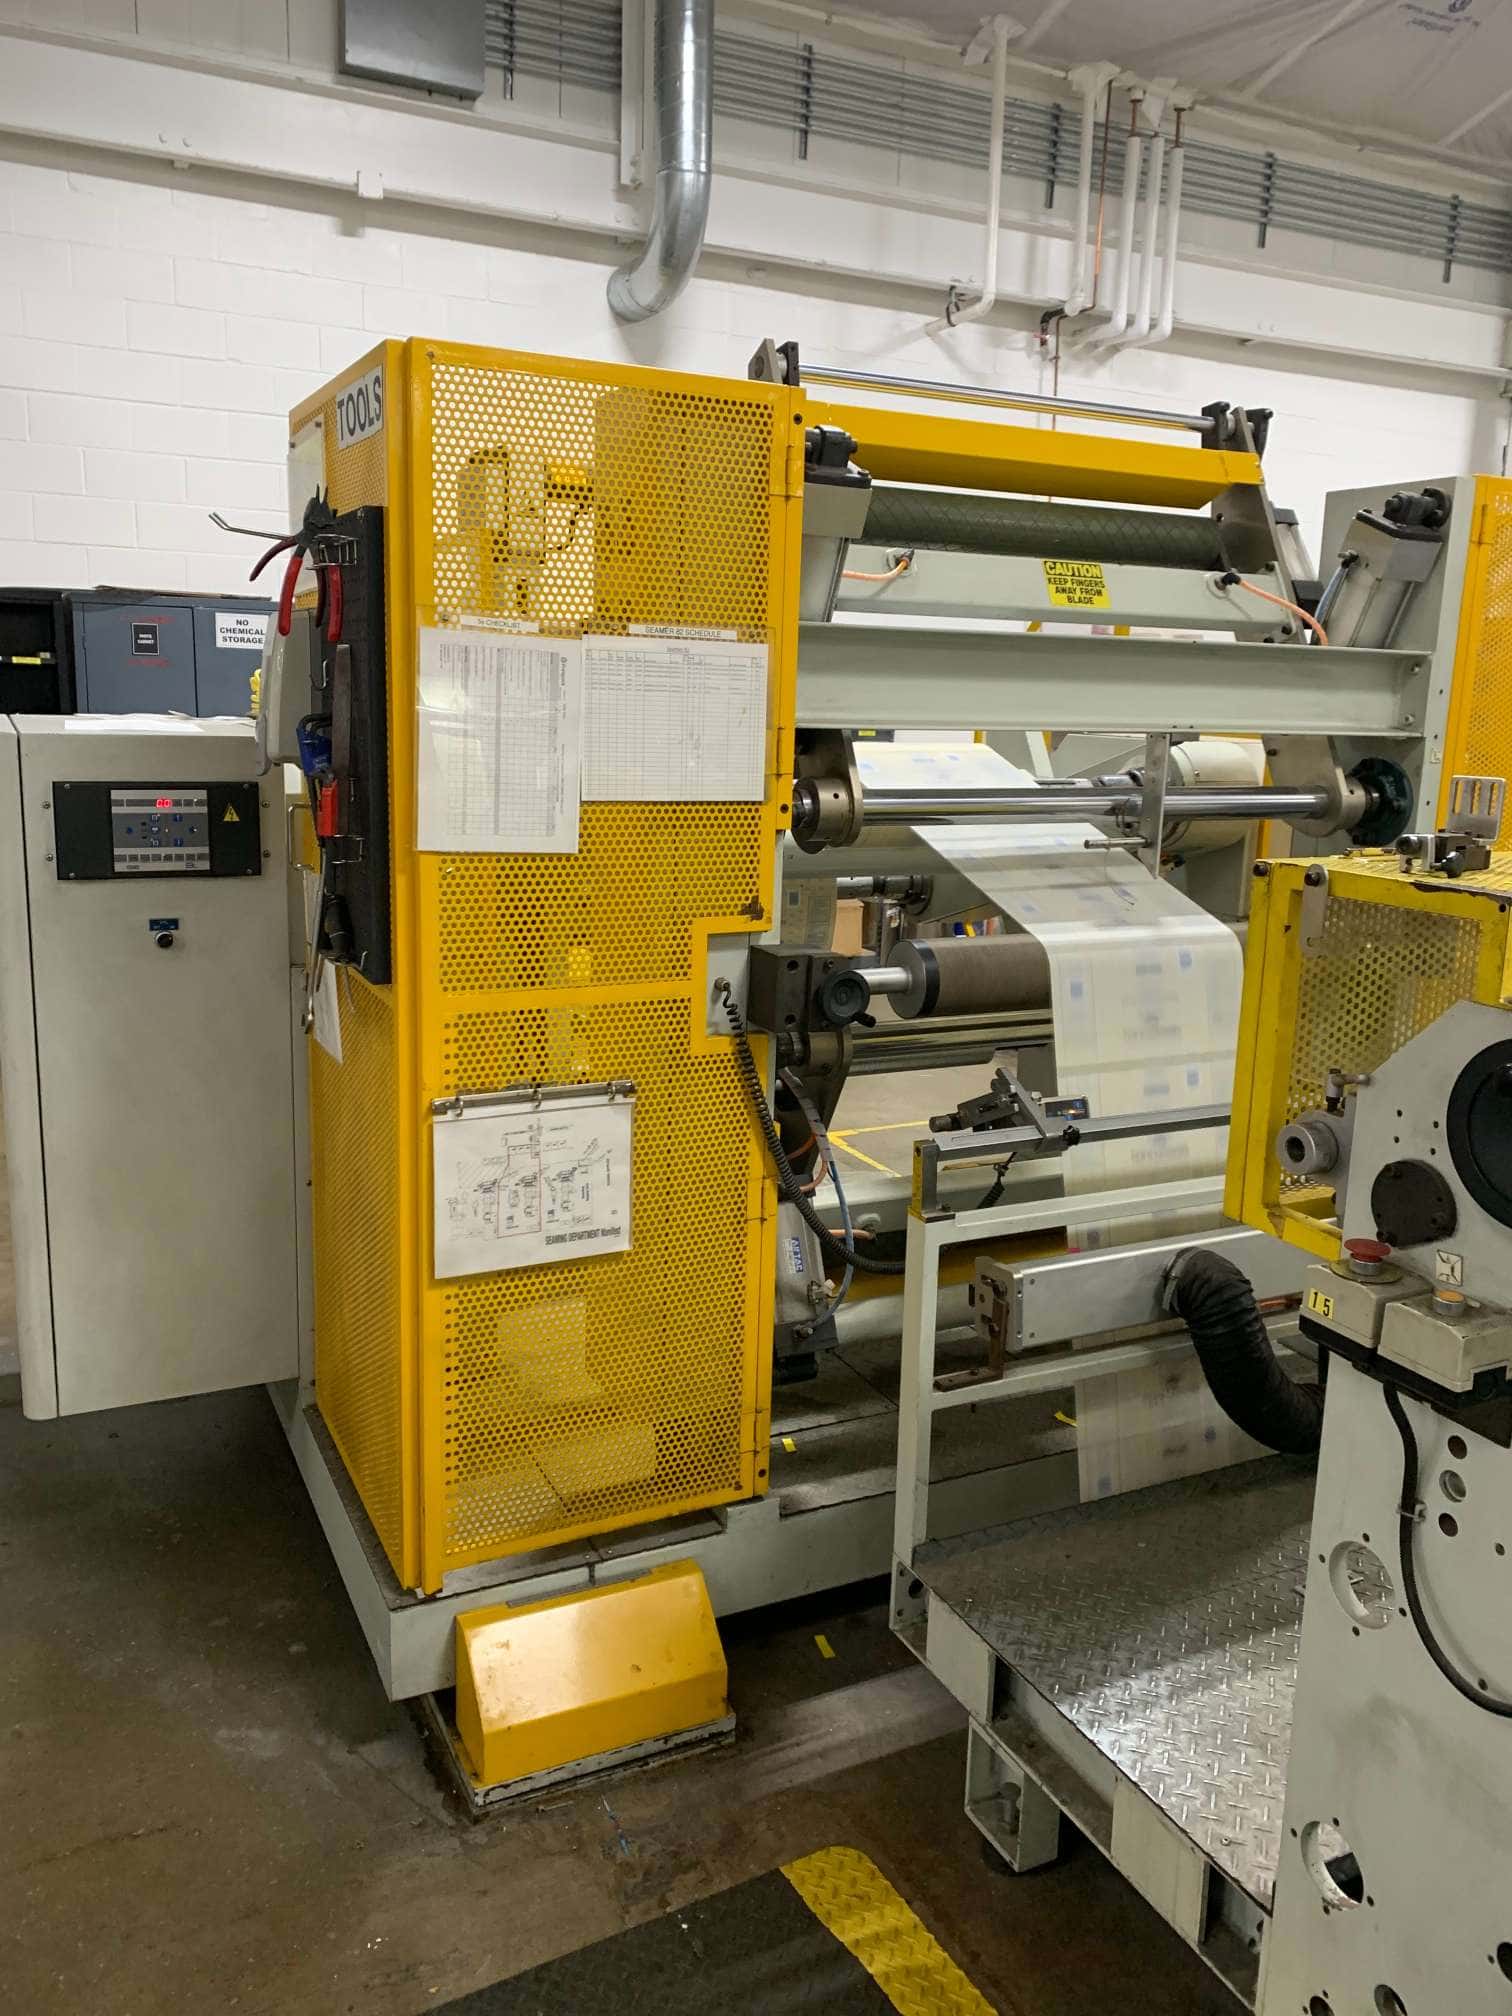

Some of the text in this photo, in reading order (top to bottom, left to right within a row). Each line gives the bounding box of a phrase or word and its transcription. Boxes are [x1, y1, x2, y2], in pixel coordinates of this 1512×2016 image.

[337, 375, 382, 441] TOOLS
[1046, 562, 1101, 577] CAUTION
[1048, 577, 1105, 588] KEEP FINGERS
[1055, 586, 1103, 597] AWAY FROM
[1067, 596, 1094, 604] BLADE
[220, 627, 265, 635] CHEMICAL
[685, 629, 721, 638] SCHEDULE
[222, 636, 264, 644] STORAGE
